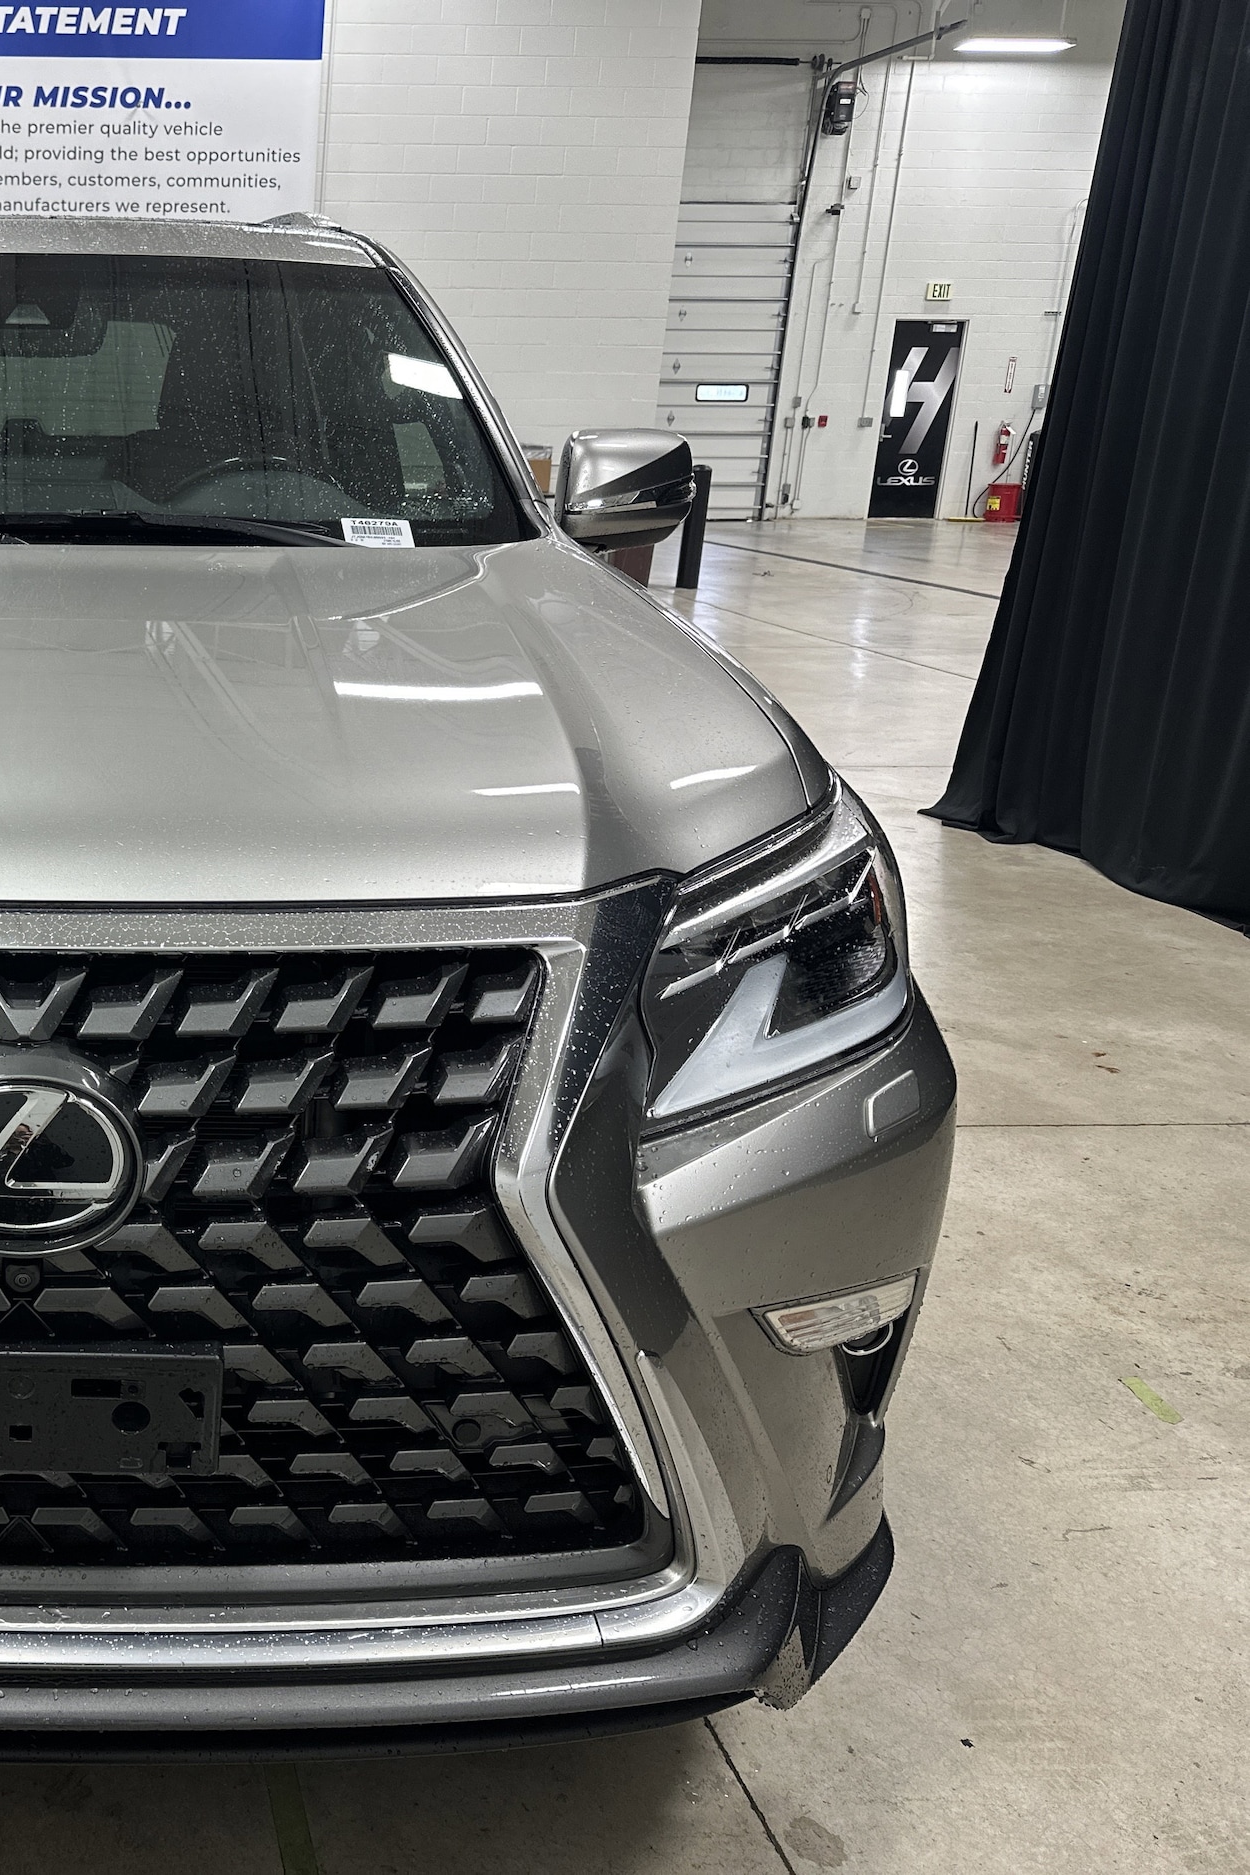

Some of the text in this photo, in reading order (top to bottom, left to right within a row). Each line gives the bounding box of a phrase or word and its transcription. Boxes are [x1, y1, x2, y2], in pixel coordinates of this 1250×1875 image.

[34, 86, 192, 110] MISSION...
[28, 121, 95, 137] premier
[101, 121, 159, 139] quality
[163, 122, 223, 136] vehicle
[24, 146, 104, 164] providing
[110, 147, 138, 161] the
[144, 147, 181, 162] best
[186, 147, 301, 165] opportunities
[67, 174, 161, 190] customers,
[166, 174, 281, 191] communities,
[115, 202, 140, 213] we
[146, 201, 230, 216] represent.
[932, 283, 951, 298] EXIT
[877, 476, 935, 486] LEXUS
